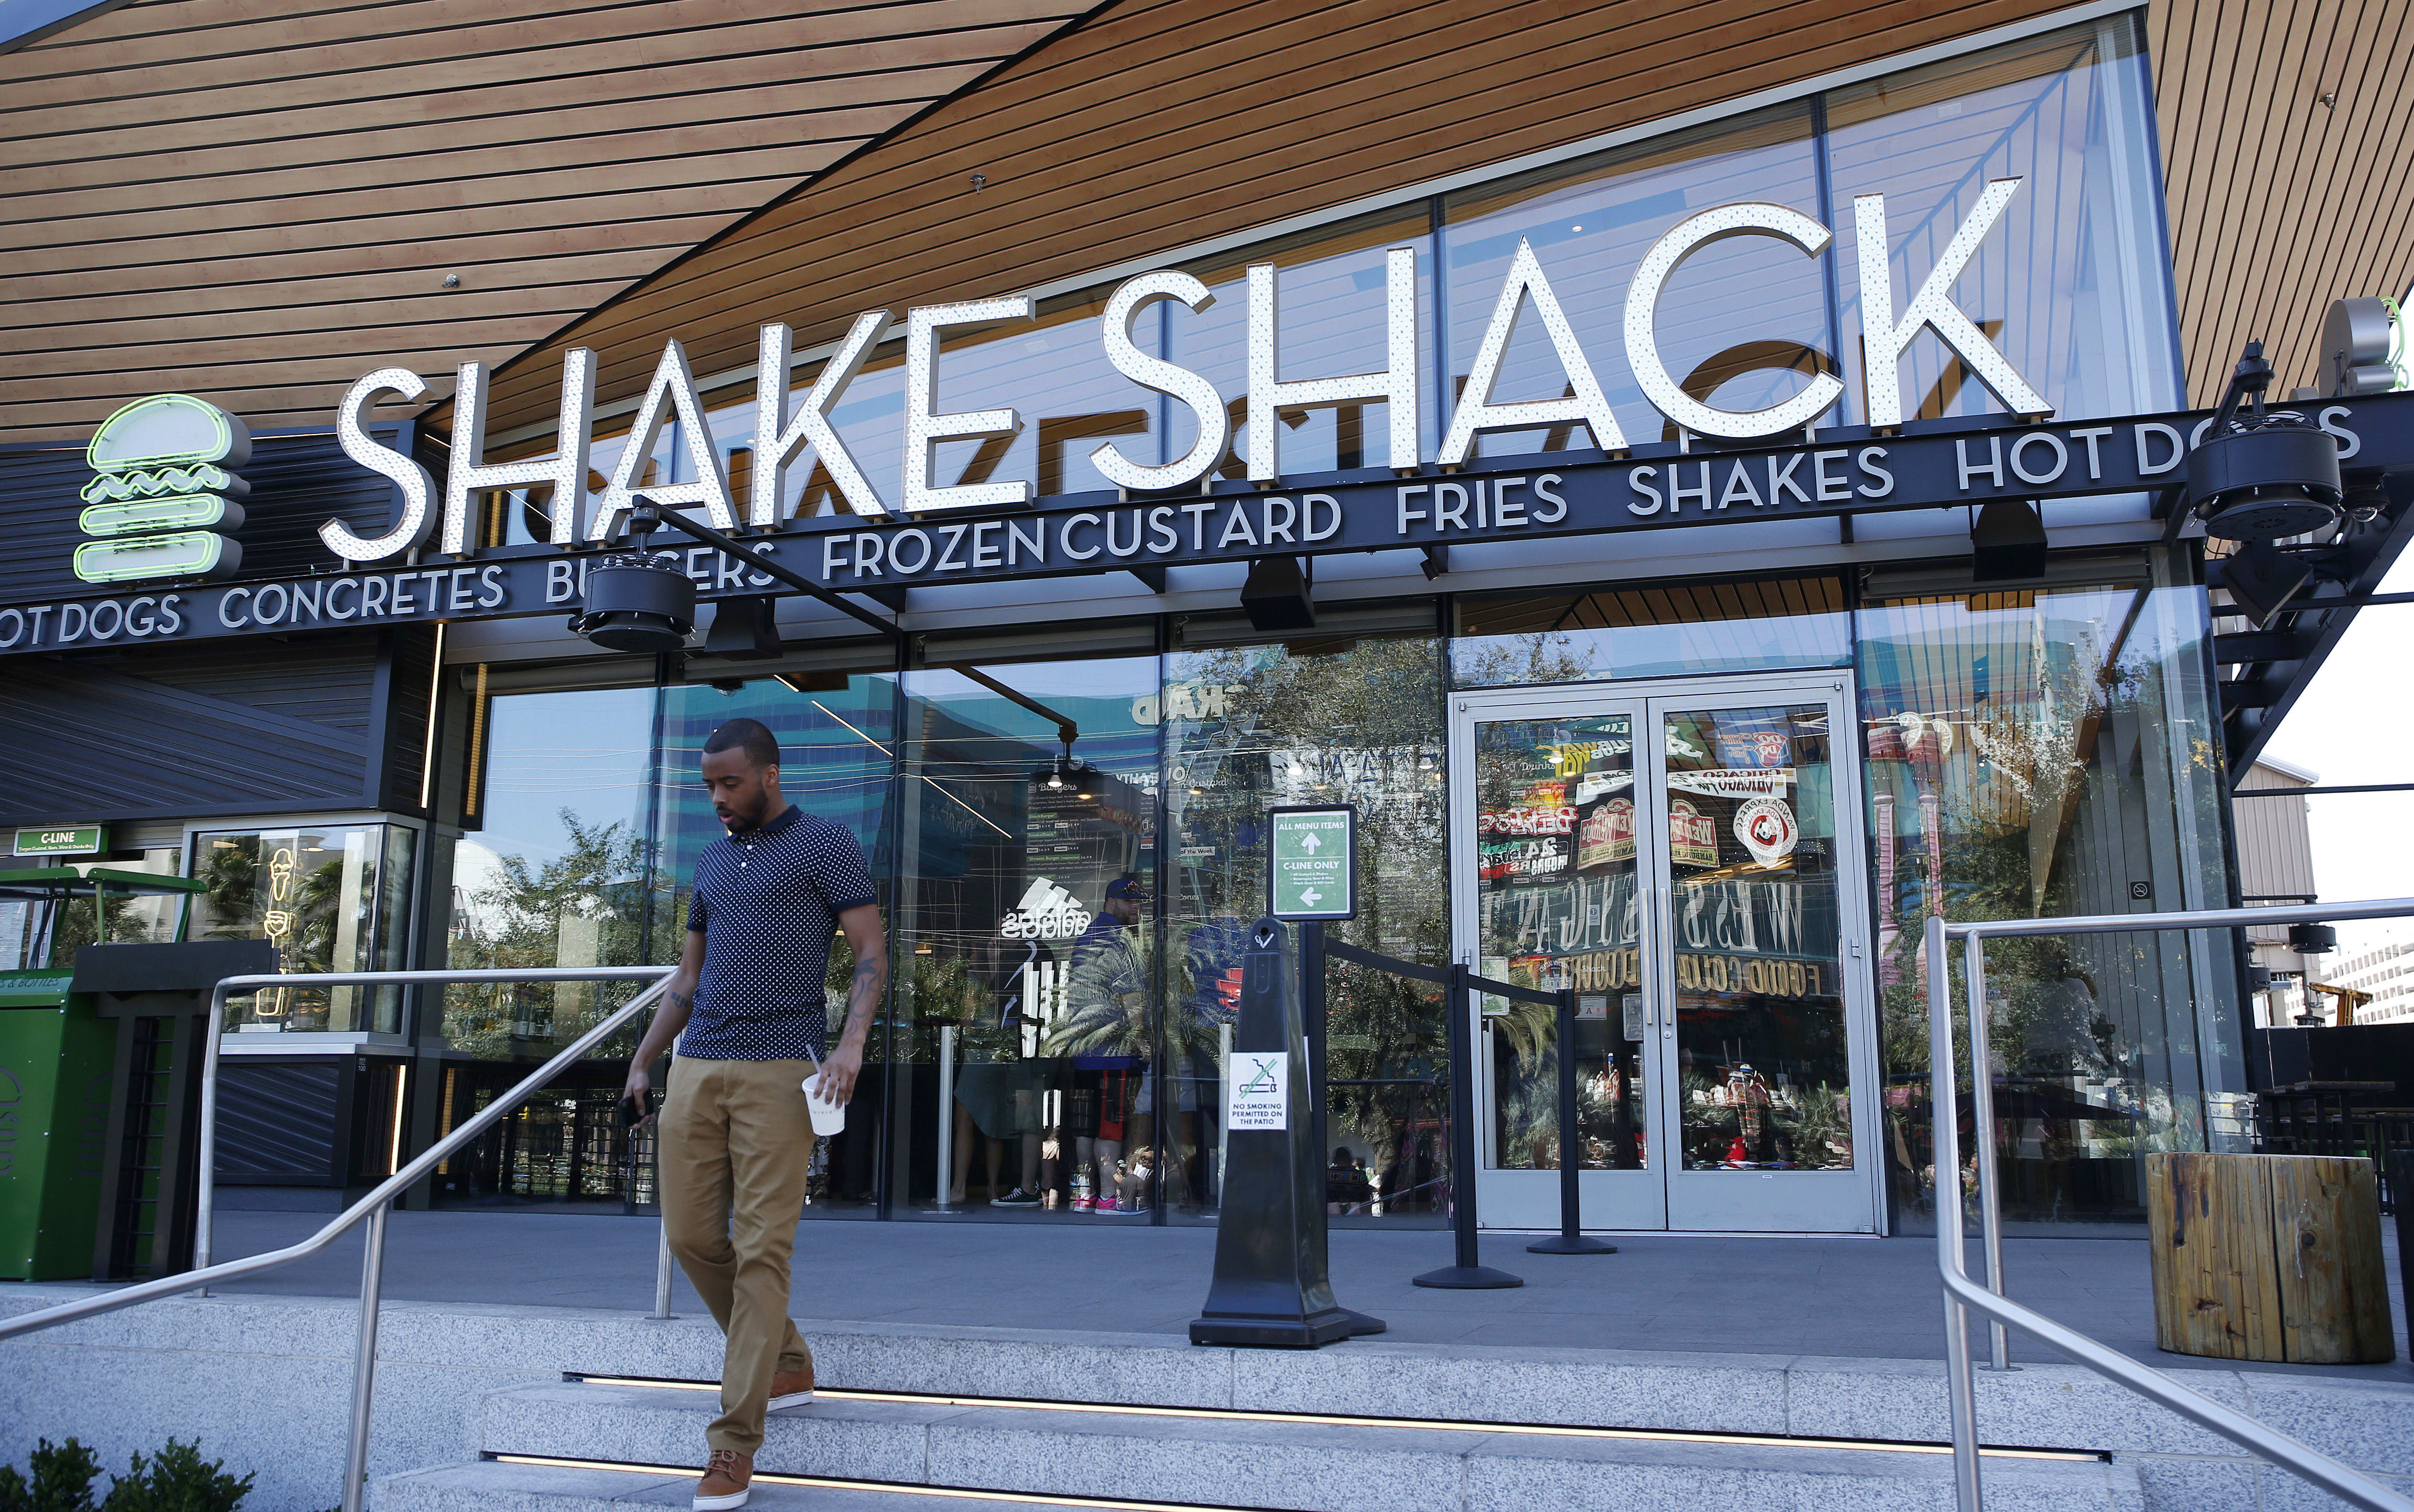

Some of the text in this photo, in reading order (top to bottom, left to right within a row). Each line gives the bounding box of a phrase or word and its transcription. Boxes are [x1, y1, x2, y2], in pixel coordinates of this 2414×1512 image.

[317, 175, 2055, 562] SHAKE SHACK
[1627, 446, 1894, 515] SHAKES
[1955, 425, 2115, 490] HOT
[1397, 473, 1568, 535] FRIES
[822, 493, 1341, 580] FROZEN CUSTARD
[58, 594, 180, 642] DOGS
[219, 565, 503, 627] CONCRETES
[1520, 762, 1556, 771] Drinks
[41, 832, 75, 843] C-LINE
[1284, 862, 1312, 870] C-LINE
[18, 978, 59, 987] BOTTLES
